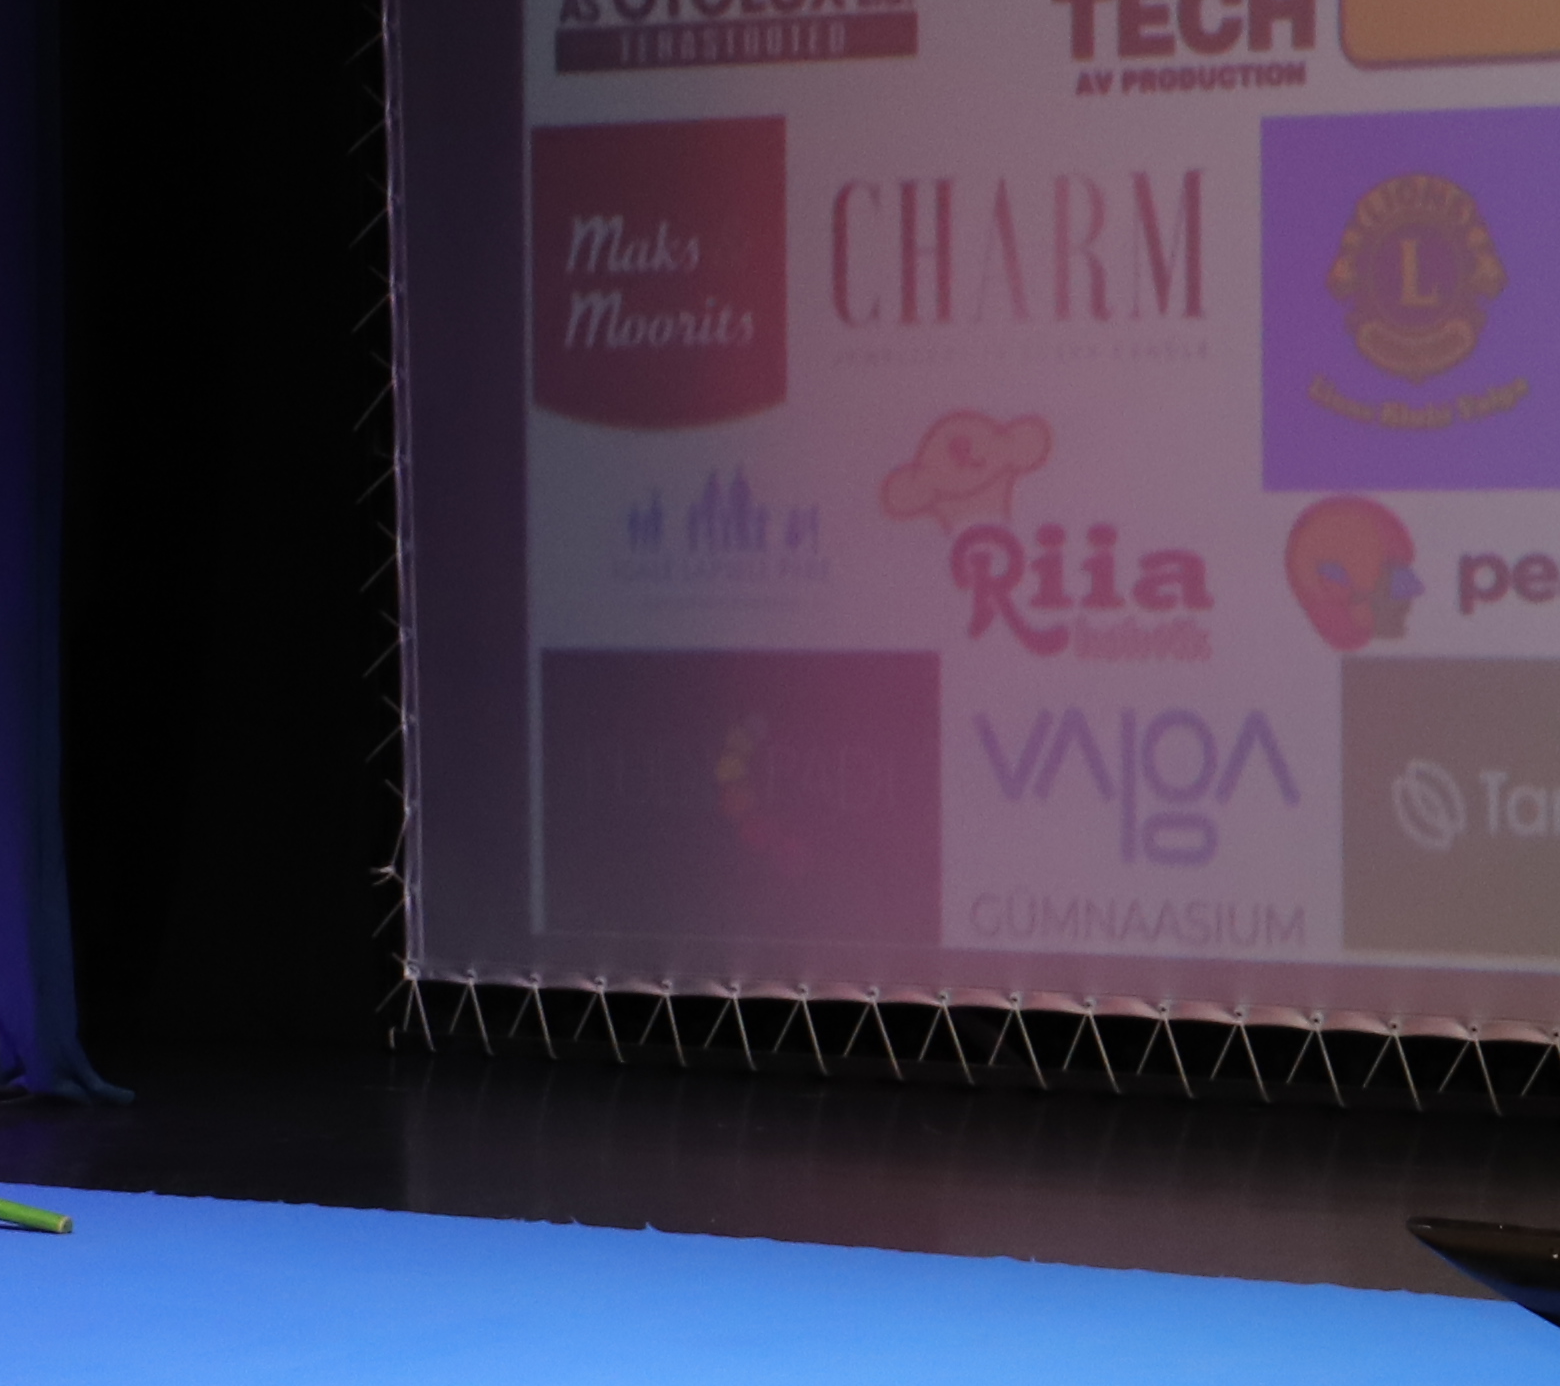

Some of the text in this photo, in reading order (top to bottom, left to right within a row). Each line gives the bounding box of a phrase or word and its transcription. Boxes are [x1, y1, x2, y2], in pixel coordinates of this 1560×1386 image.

[1075, 61, 1307, 96] AV PRODUCTION
[564, 213, 701, 275] Maks
[829, 167, 1207, 330] CHARM
[948, 523, 1216, 658] Riia
[969, 885, 1307, 949] GÜMNAASIUM
